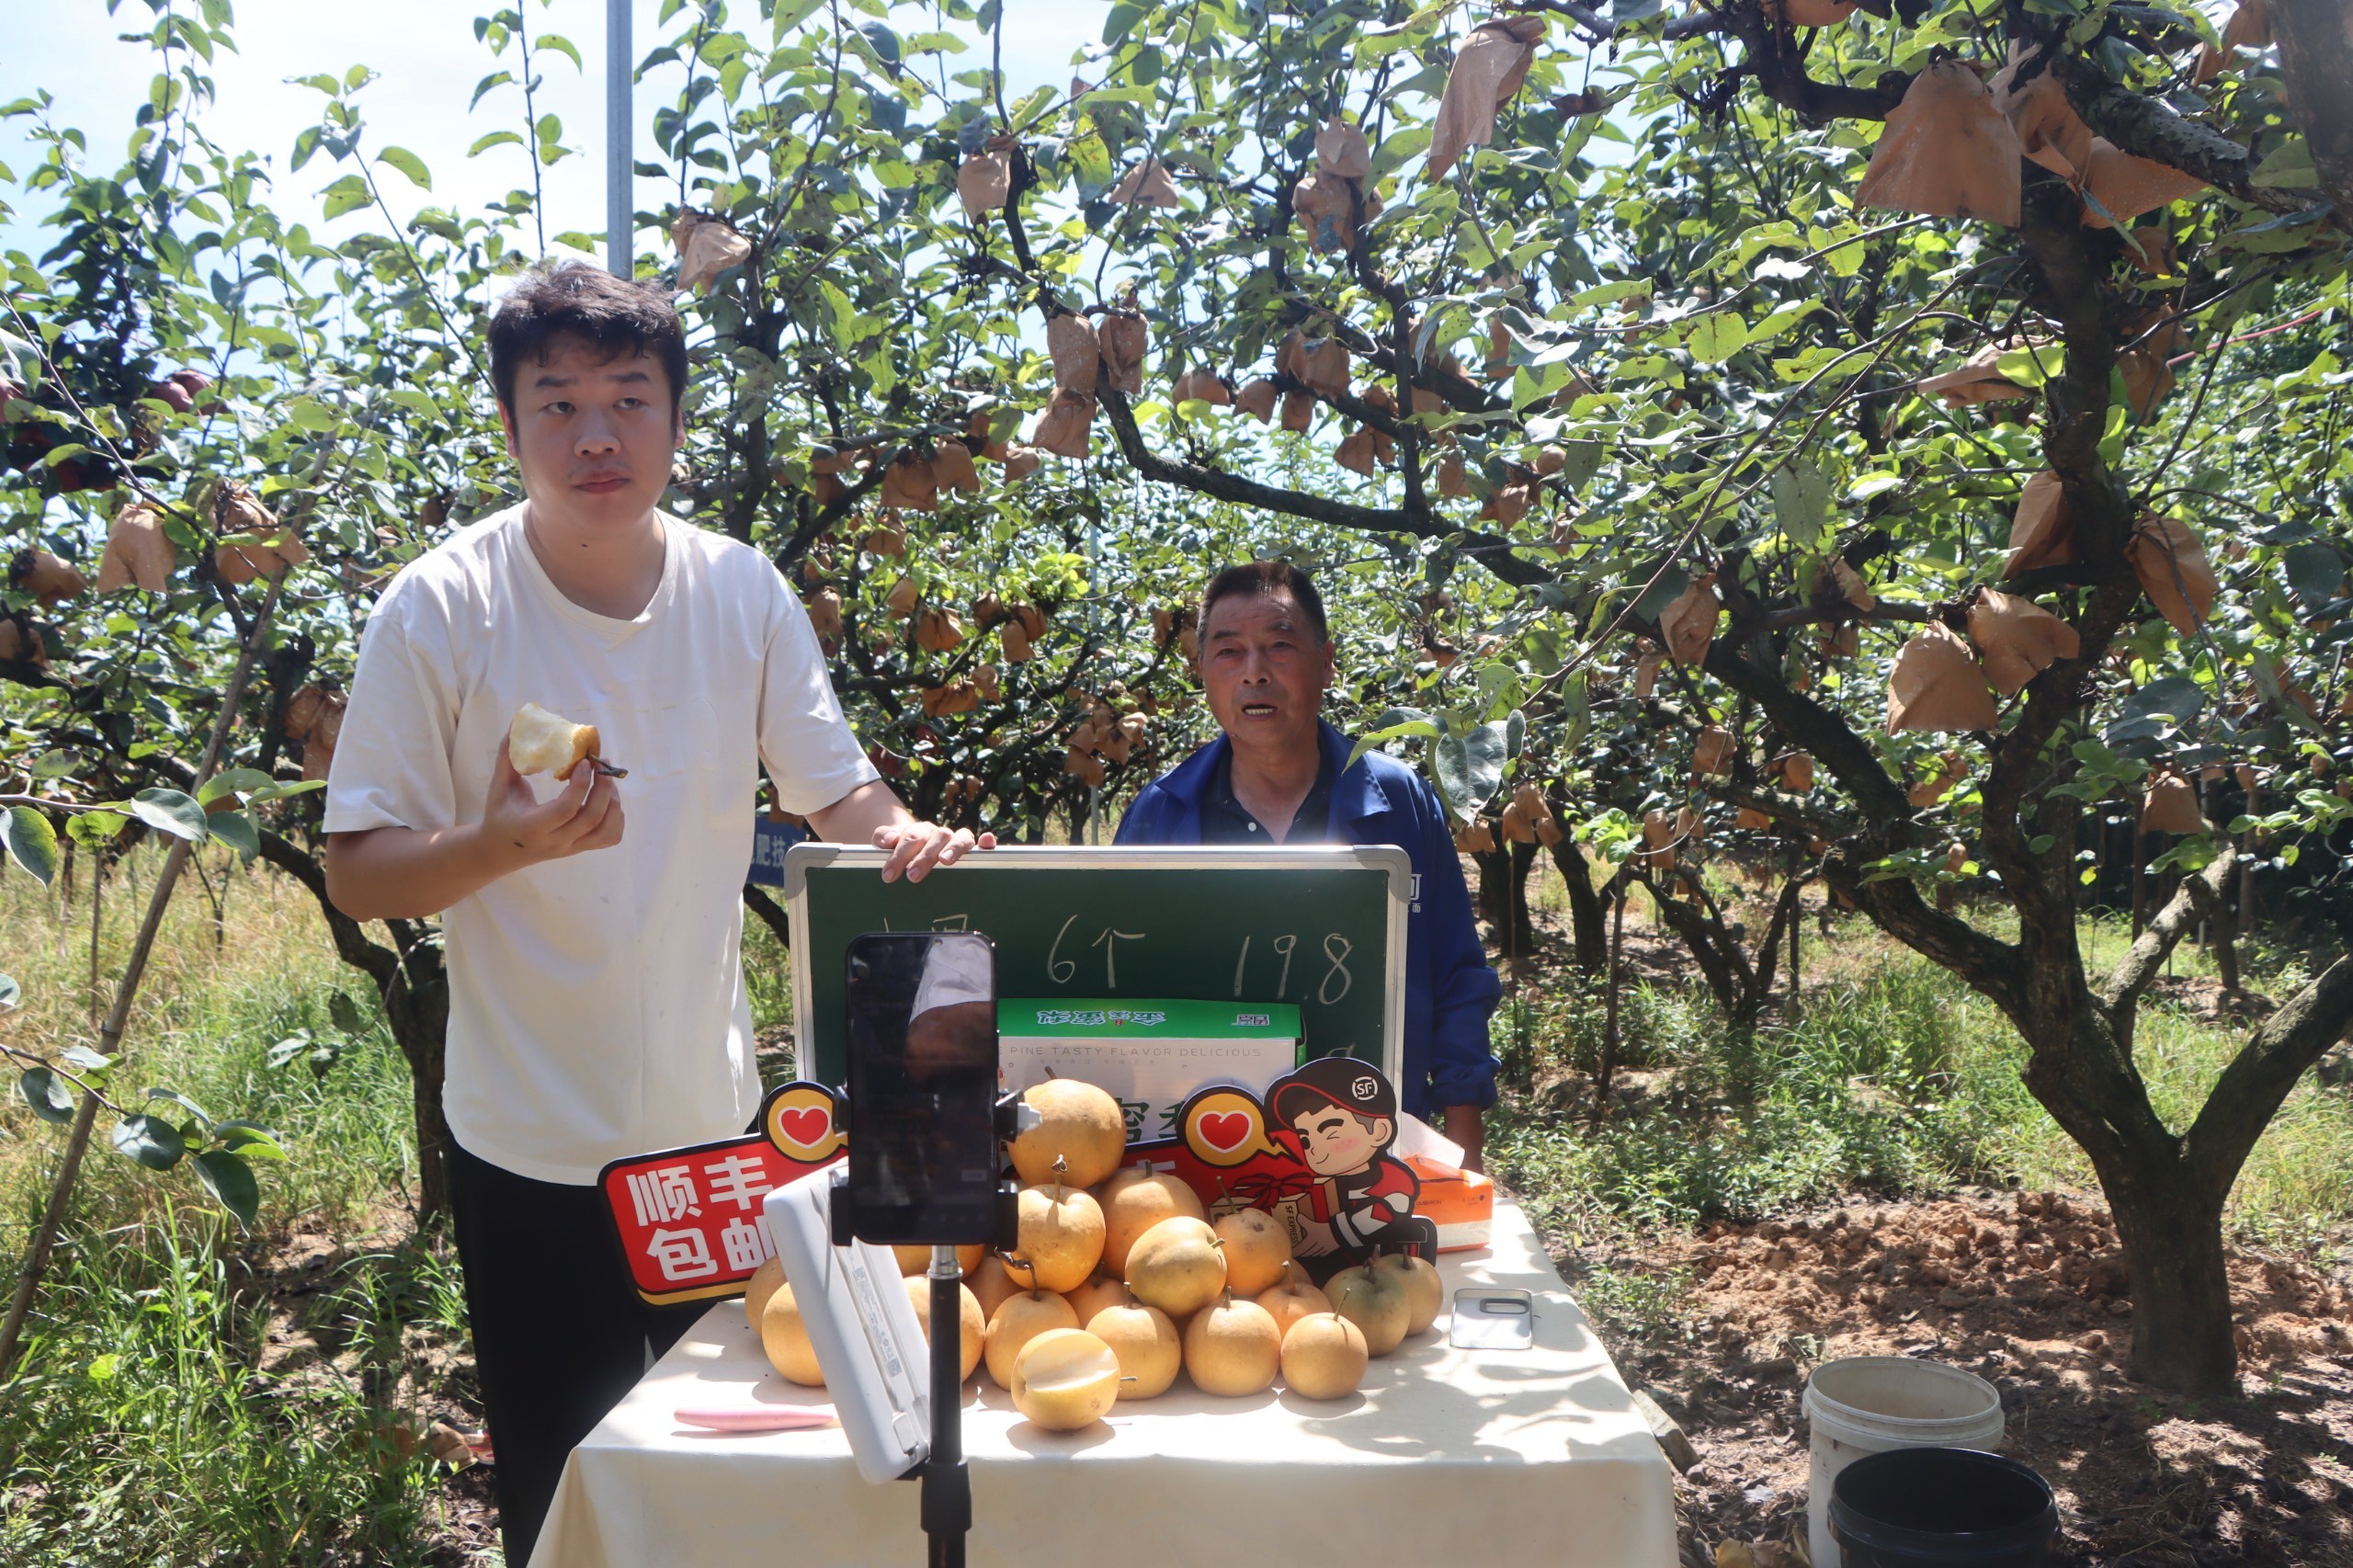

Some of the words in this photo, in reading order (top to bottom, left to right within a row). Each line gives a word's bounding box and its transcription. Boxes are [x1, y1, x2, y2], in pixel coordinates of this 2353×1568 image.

[752, 833, 798, 868] 肥技
[1046, 914, 1146, 989] 6个
[1011, 1046, 1044, 1055] PINE
[1051, 1047, 1103, 1056] TASTY
[1109, 1047, 1173, 1057] FLAVOR
[1179, 1048, 1263, 1057] DELICIOUS
[626, 1155, 774, 1226] 顺丰
[1285, 1205, 1294, 1215] SF
[1287, 1216, 1298, 1244] EXPRESS
